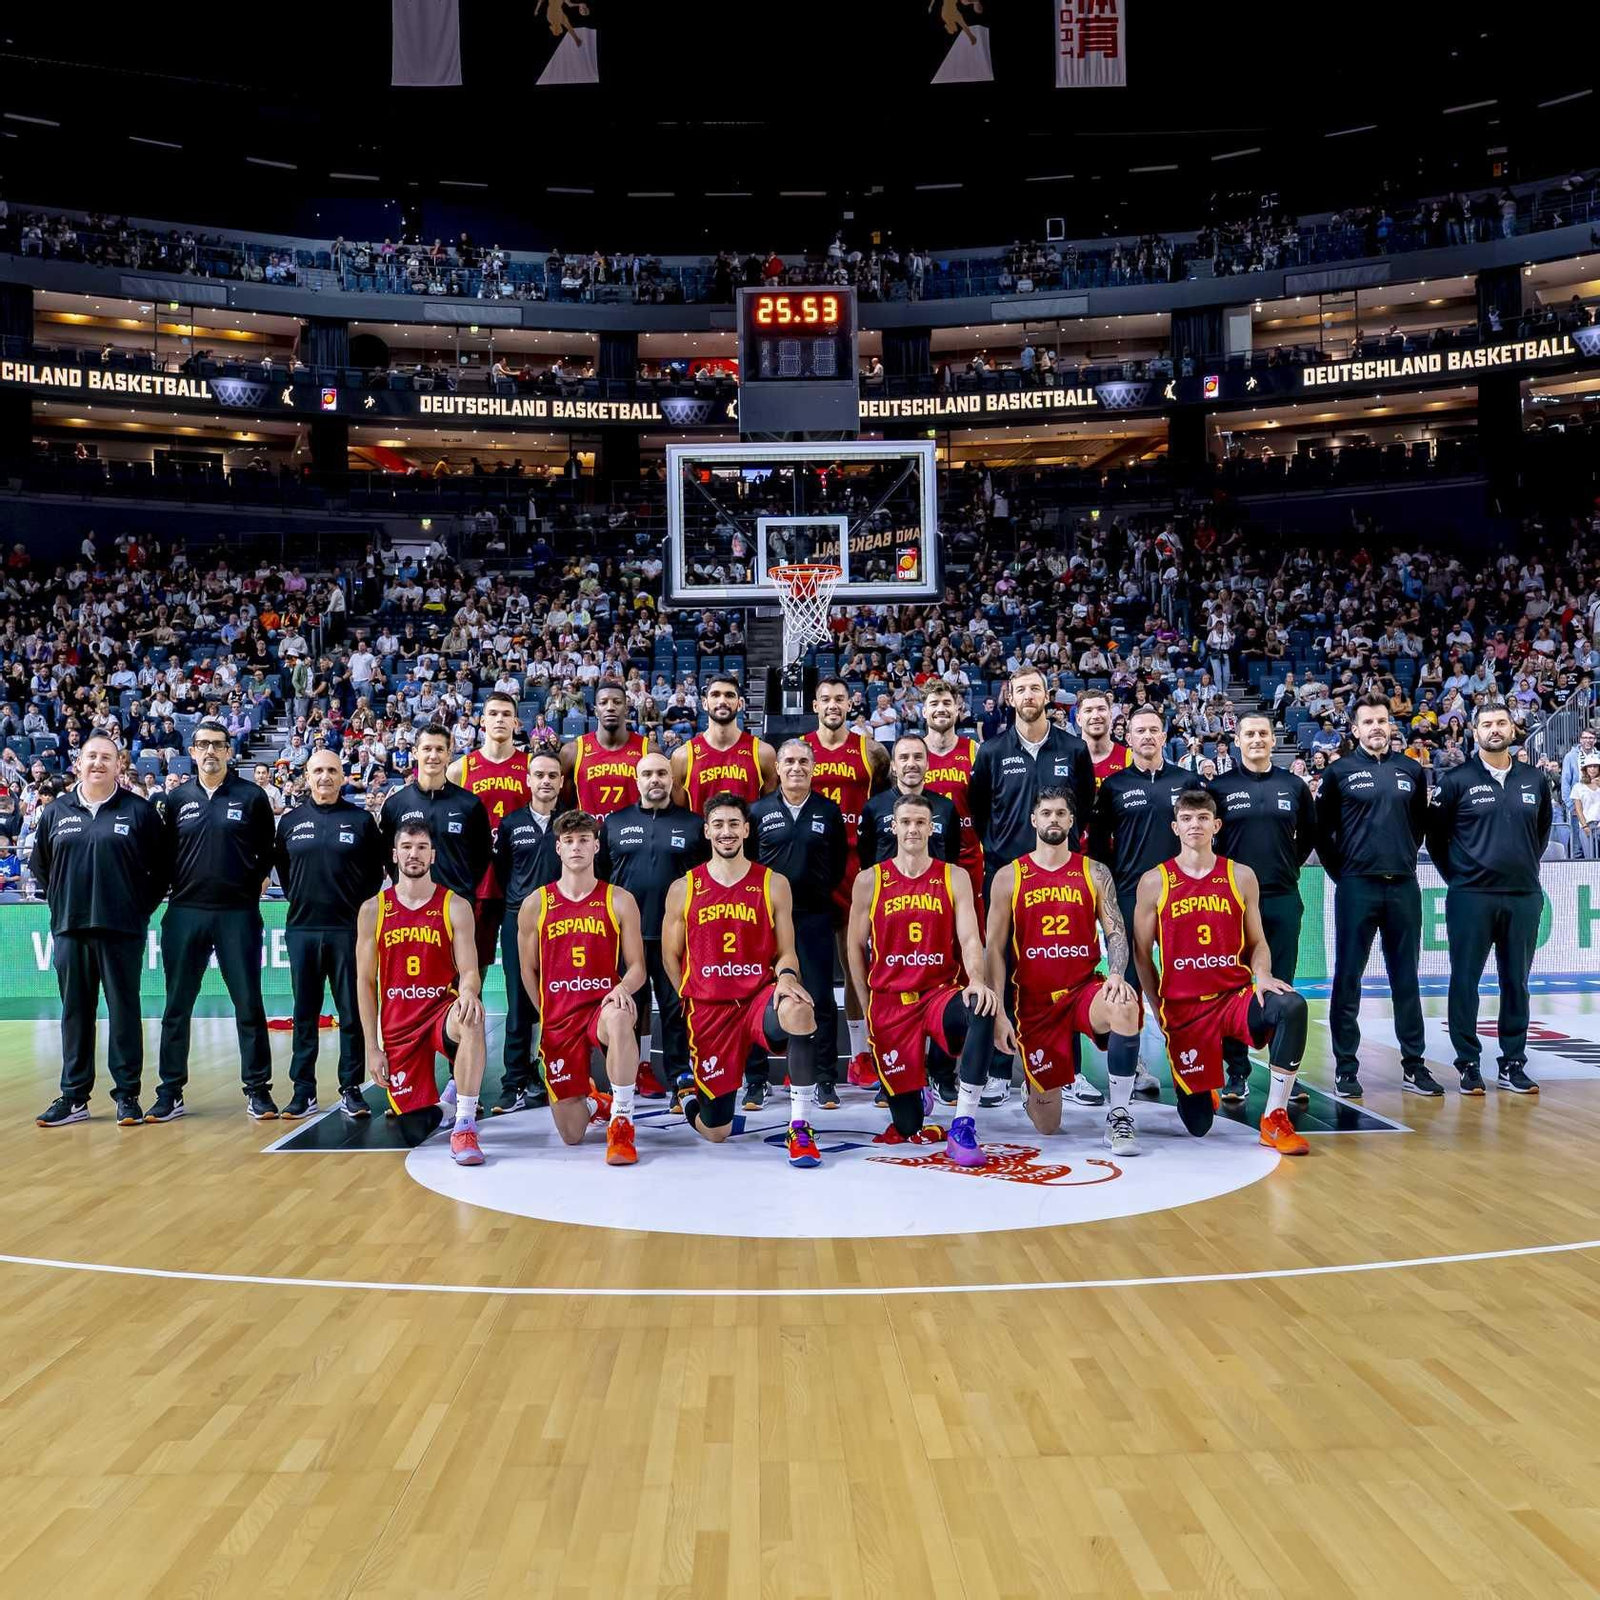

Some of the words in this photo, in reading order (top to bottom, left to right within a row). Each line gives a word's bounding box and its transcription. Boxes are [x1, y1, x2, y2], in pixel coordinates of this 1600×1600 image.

[1060, 0, 1073, 58] ORT
[757, 296, 838, 324] 25.53
[1303, 353, 1442, 387] DEUTSCHLAND
[1448, 336, 1575, 371] BASKETBALL
[88, 370, 212, 400] BASKETBALL
[420, 395, 547, 418] DEUTSCHLAND
[552, 400, 663, 420] BASKETBALL
[859, 395, 981, 418] DEUTSCHLAND
[986, 388, 1098, 411] BASKETBALL
[898, 570, 917, 578] DBB
[587, 762, 638, 781] ESPAÑA
[812, 762, 857, 781] SPAÑA
[1002, 755, 1025, 767] ESPAÑA
[699, 762, 748, 785] ESPAÑA
[924, 767, 968, 785] SPAÑA
[472, 776, 524, 796] ESPAÑA
[600, 786, 624, 804] 77
[821, 787, 842, 805] 14
[492, 800, 505, 818] 4
[884, 893, 944, 917] ESPAÑA
[1024, 884, 1084, 909] ESPAÑA
[1171, 893, 1233, 919] ESPAÑA
[698, 902, 758, 926] ESPAÑA
[547, 915, 607, 941] ESPAÑA
[908, 922, 922, 943] 6
[1041, 914, 1070, 936] 22
[1197, 924, 1212, 945] 3
[384, 924, 442, 948] ESPAÑA
[722, 932, 736, 953] 2
[571, 946, 586, 968] 5
[885, 950, 944, 967] endesa
[1026, 943, 1089, 960] endesa
[1174, 953, 1237, 971] endesa
[406, 955, 421, 976] 8
[701, 961, 762, 978] endesa
[549, 975, 612, 993] endesa
